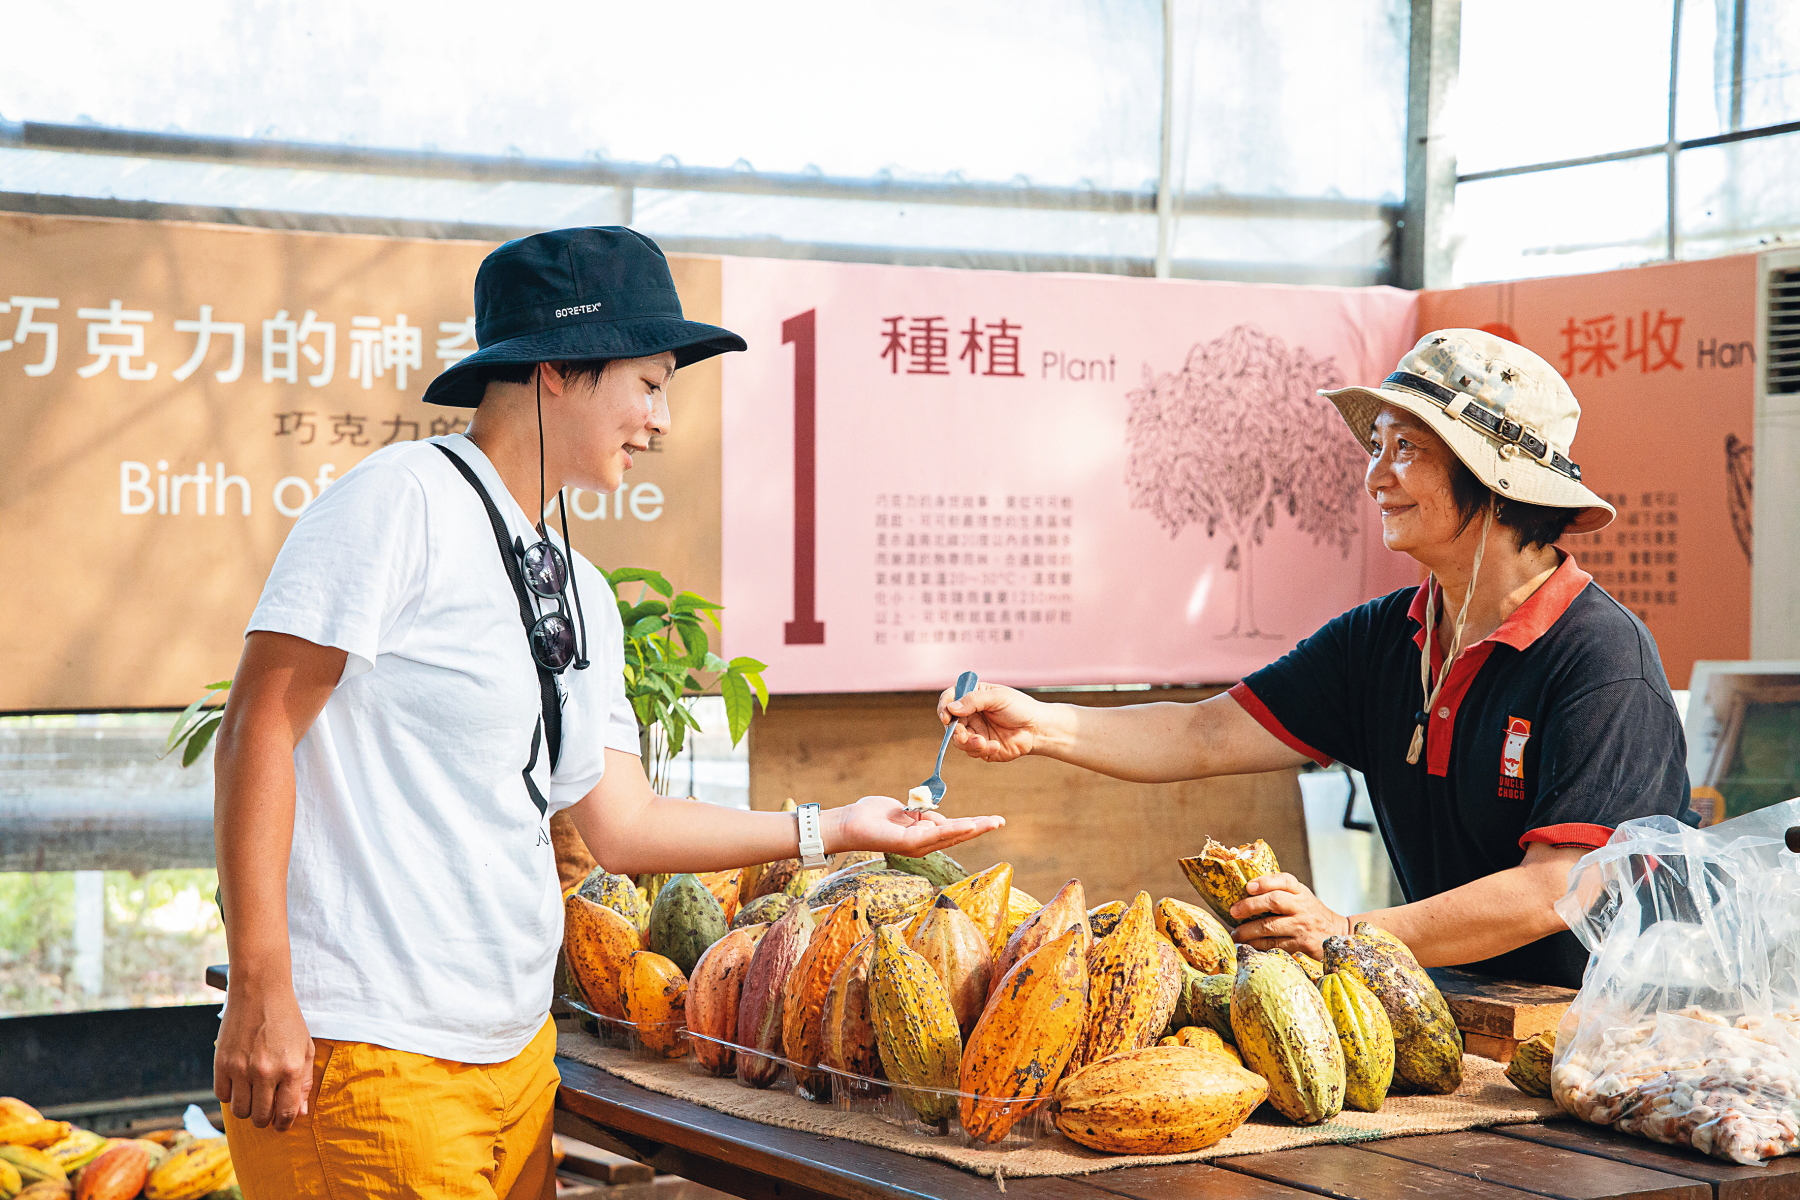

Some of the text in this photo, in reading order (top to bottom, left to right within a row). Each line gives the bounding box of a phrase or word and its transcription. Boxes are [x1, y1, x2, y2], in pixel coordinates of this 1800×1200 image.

[880, 316, 1025, 378] 種植
[1041, 350, 1117, 382] Plant
[1559, 309, 1686, 379] 採收
[119, 459, 252, 516] Birth
[782, 308, 825, 645] 1
[1498, 787, 1525, 800] CHOCO
[1499, 776, 1524, 789] UNCLE
